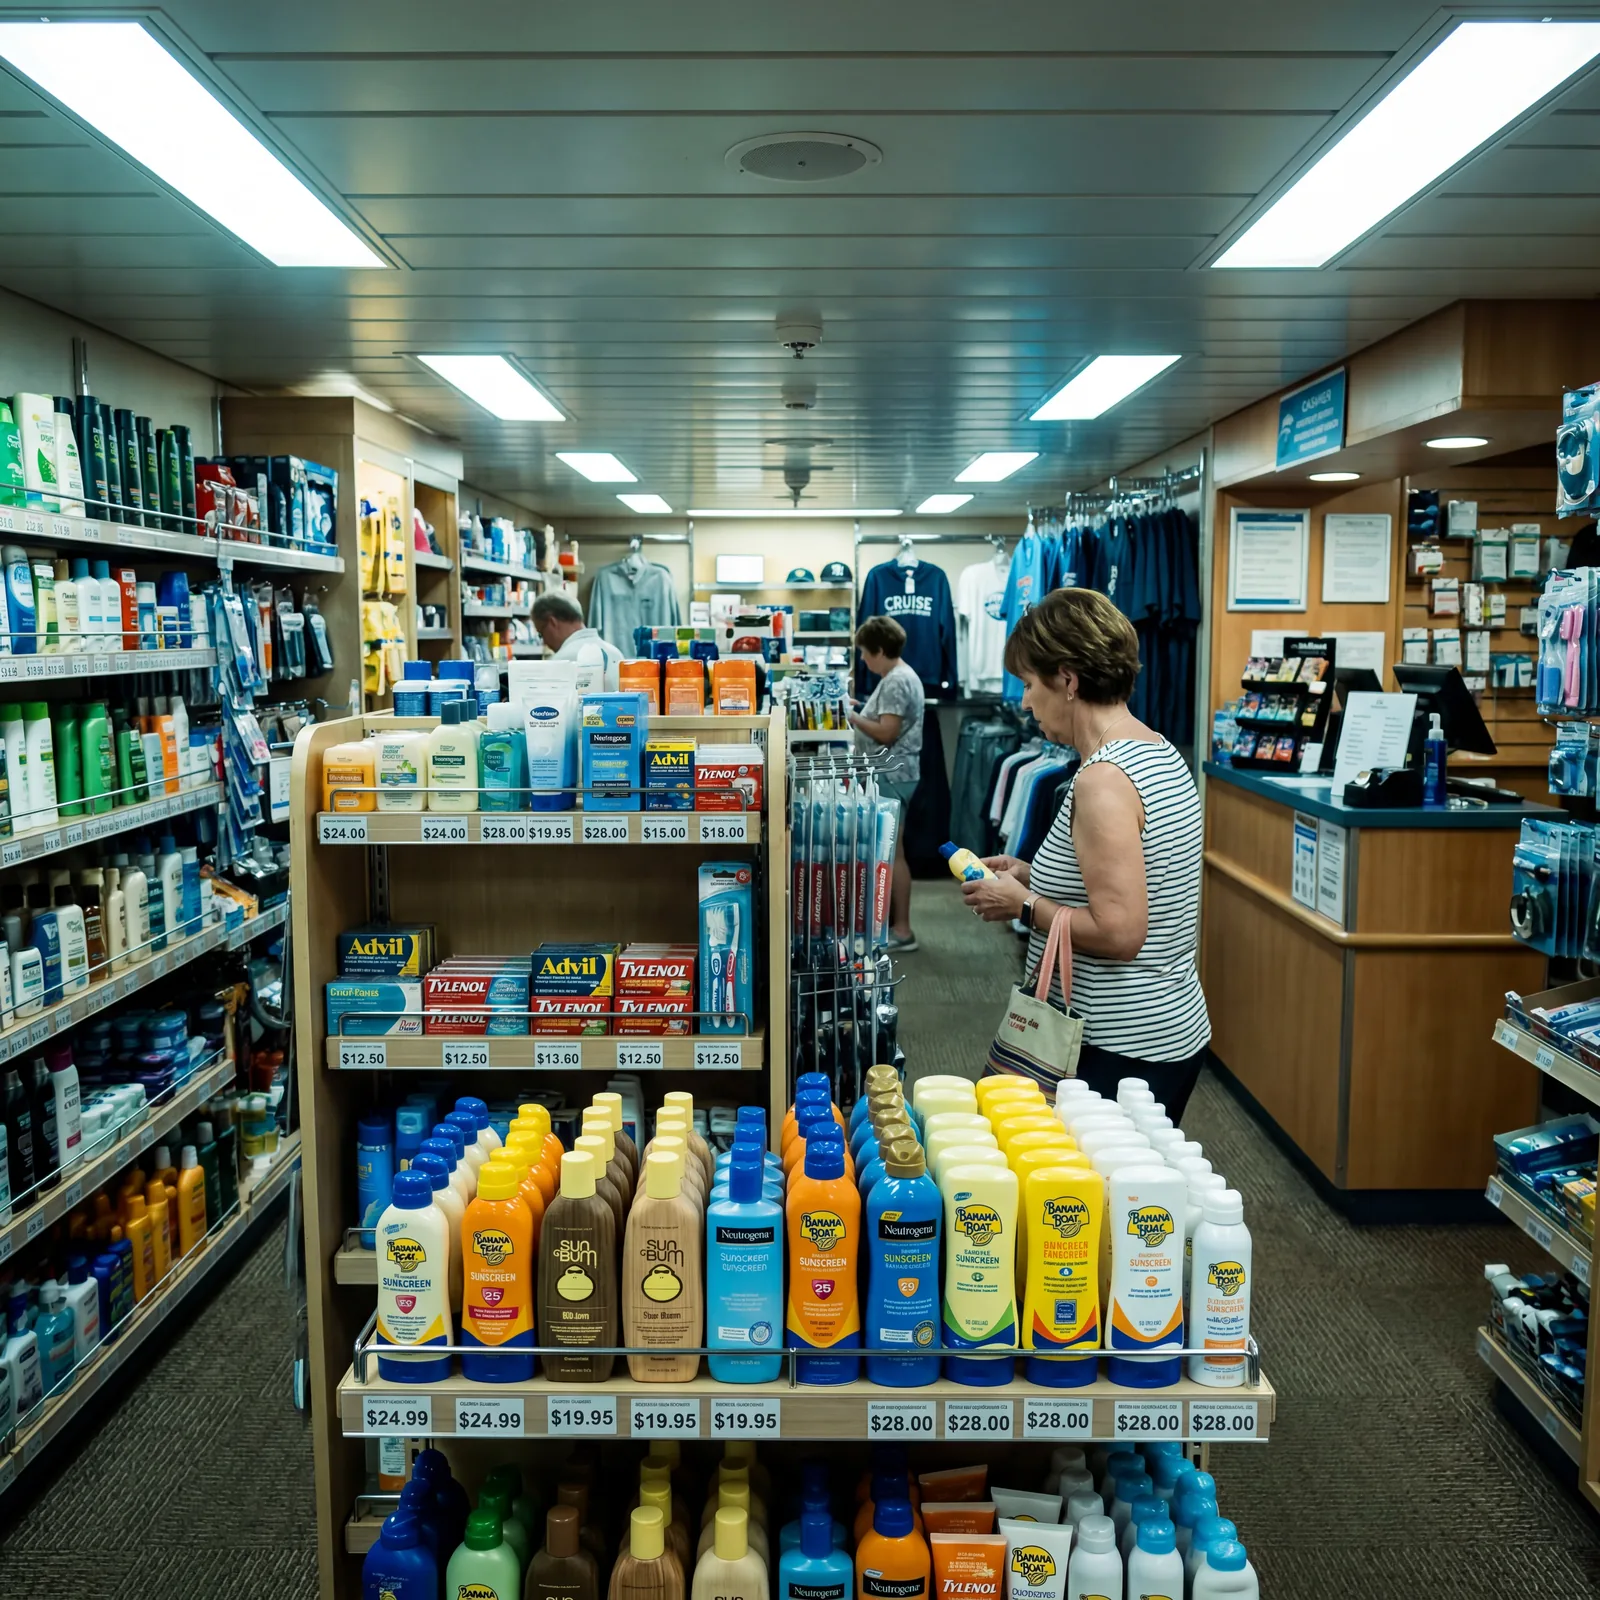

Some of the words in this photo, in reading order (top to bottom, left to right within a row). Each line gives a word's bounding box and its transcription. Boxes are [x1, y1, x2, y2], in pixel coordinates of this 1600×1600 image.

[884, 595, 933, 611] CRUISE
[651, 753, 689, 765] Advil
[323, 827, 366, 840] $24.00
[423, 827, 466, 840] $24.00
[482, 827, 525, 840] $28.00
[529, 827, 571, 840] $19.95
[584, 827, 627, 839] $28.00
[643, 827, 686, 839] $15.00
[701, 826, 744, 838] $18.00
[349, 937, 404, 955] Advil
[540, 957, 597, 975] Advil
[620, 961, 687, 978] TYLENOL
[428, 978, 487, 993] TYLENOL
[342, 1052, 384, 1065] $12.50
[445, 1052, 487, 1065] $12.50
[537, 1053, 579, 1065] $13.60
[619, 1053, 661, 1065] $12.50
[697, 1053, 739, 1065] $12.50
[1052, 1214, 1079, 1227] BOAT
[721, 1229, 770, 1241] Neutrogena
[809, 1228, 835, 1240] BOAT
[963, 1222, 992, 1235] BOAT
[560, 1239, 590, 1252] SUN
[646, 1239, 677, 1251] SUN
[553, 1250, 597, 1269] BUM
[640, 1249, 684, 1267] BUM
[799, 1257, 847, 1267] SUNSCREEN
[884, 1253, 931, 1264] SUNSCREEN
[1129, 1258, 1172, 1267] SUNSCREEN
[470, 1271, 516, 1282] SUNSCREEN
[814, 1284, 832, 1293] 25
[484, 1291, 502, 1301] 25
[367, 1409, 428, 1427] $24.99
[459, 1412, 521, 1429] $24.99
[551, 1409, 614, 1427] $19.95
[634, 1412, 696, 1430] $19.95
[714, 1412, 777, 1430] $19.95
[871, 1414, 933, 1432] $28.00
[948, 1414, 1010, 1432] $28.00
[1027, 1411, 1089, 1429] $28.00
[1117, 1415, 1179, 1433] $28.00
[1192, 1415, 1254, 1433] $28.00
[1014, 1550, 1052, 1564] BANANA
[1021, 1562, 1046, 1575] BOAT
[871, 1581, 919, 1595] Neutrogena
[943, 1579, 997, 1594] TYLENOL
